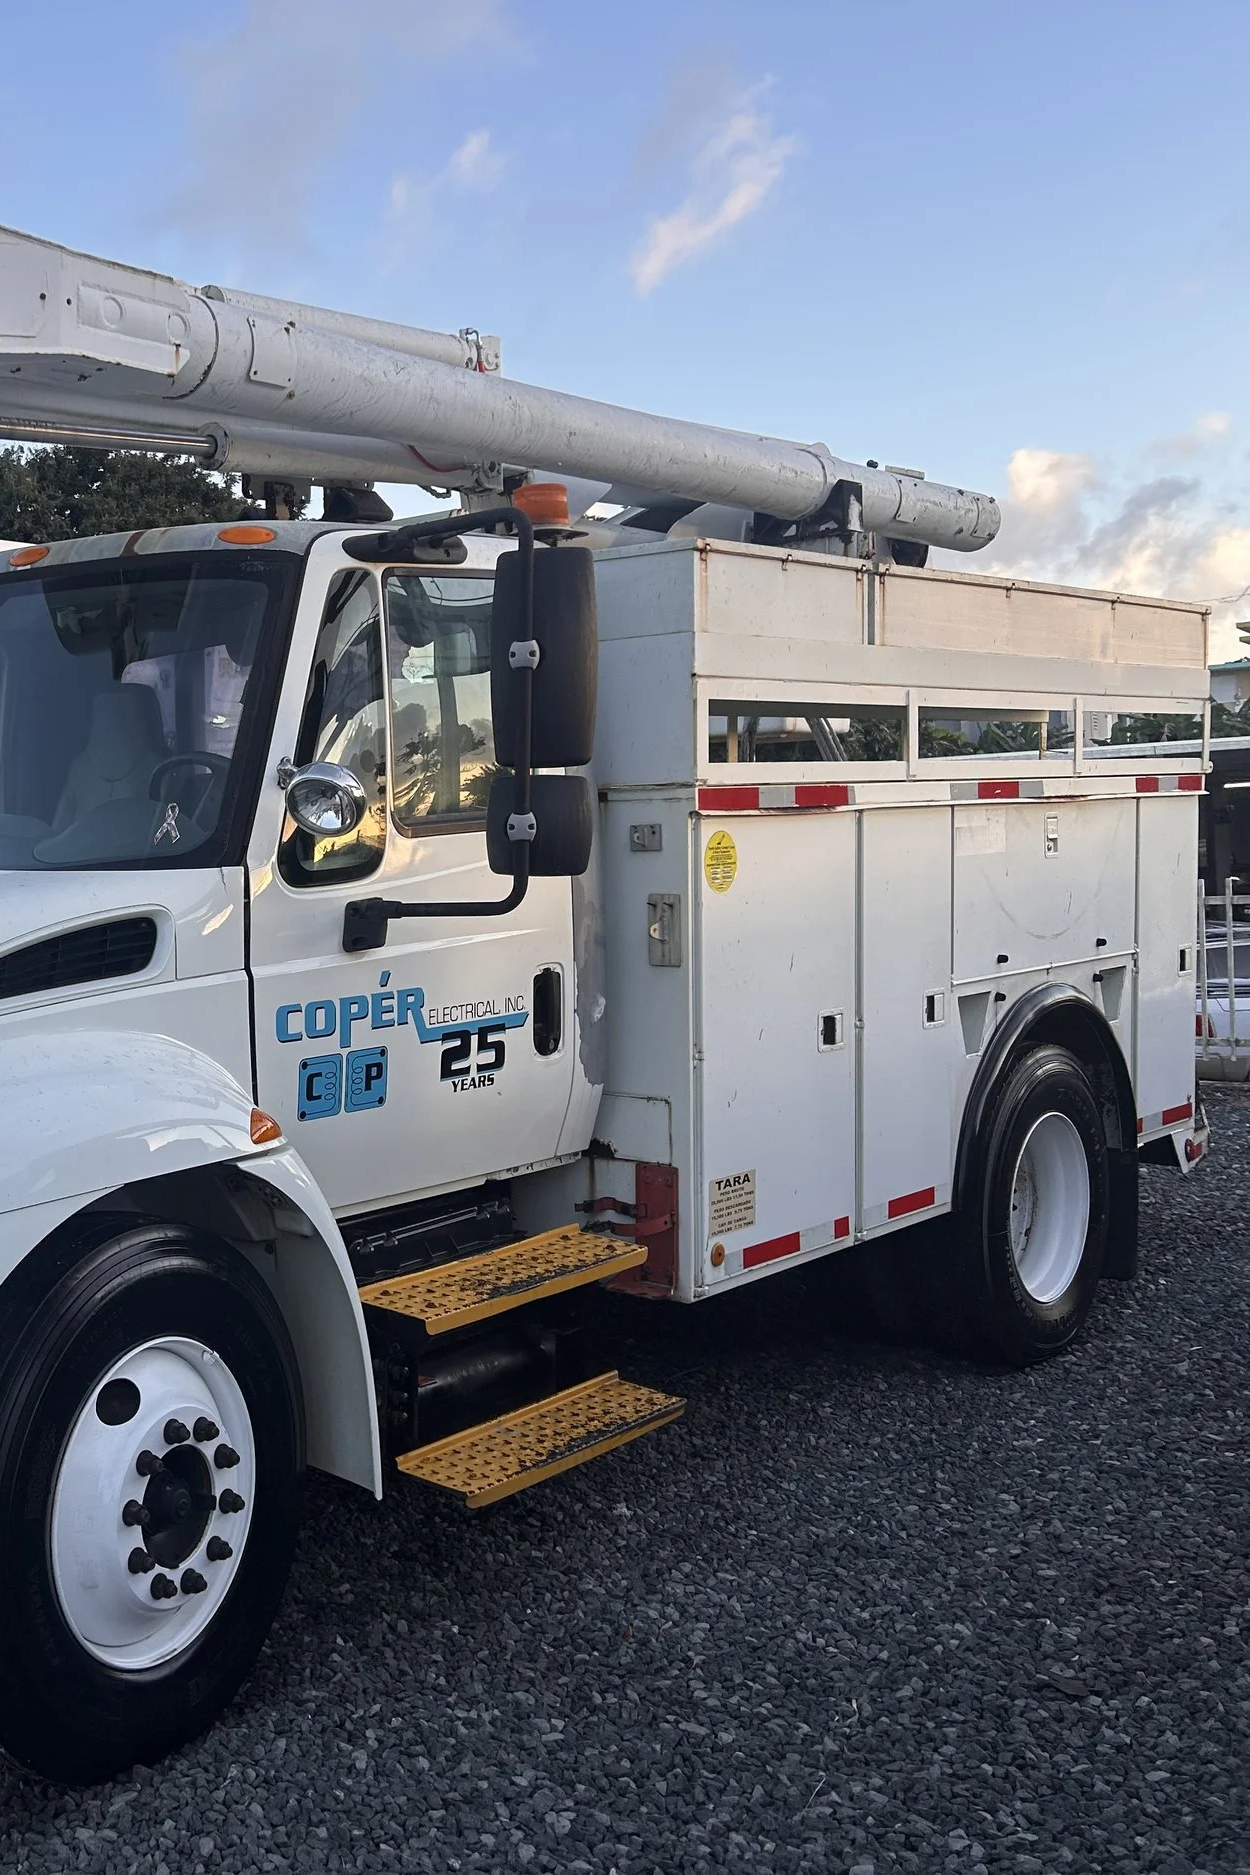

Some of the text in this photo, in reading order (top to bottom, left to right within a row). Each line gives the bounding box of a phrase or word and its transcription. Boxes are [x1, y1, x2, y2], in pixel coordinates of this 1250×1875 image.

[275, 970, 430, 1048] COPÉR
[504, 995, 527, 1013] INC.
[440, 1024, 507, 1082] 25
[305, 1061, 384, 1102] C P
[451, 1072, 495, 1093] YEARS
[716, 1174, 751, 1190] TARA
